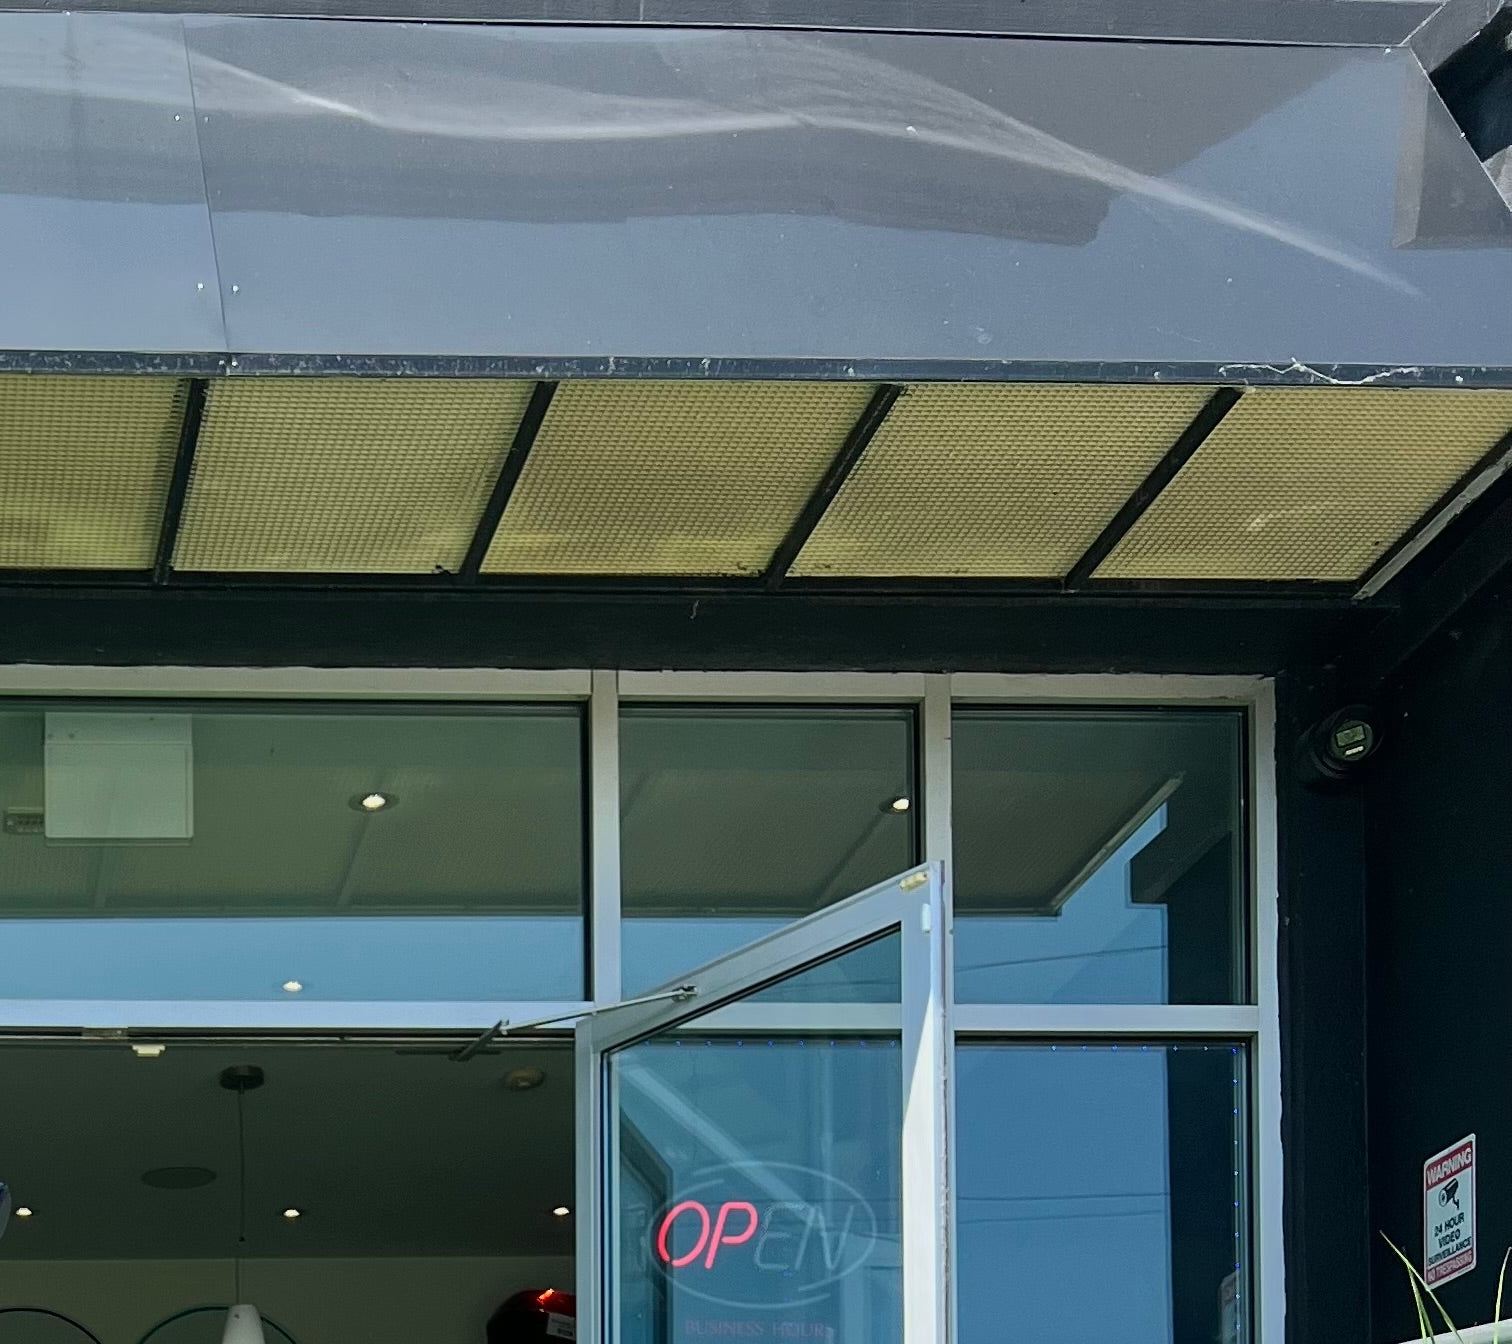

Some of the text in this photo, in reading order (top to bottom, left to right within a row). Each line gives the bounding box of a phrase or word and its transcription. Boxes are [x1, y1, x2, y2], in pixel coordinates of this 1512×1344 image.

[1427, 1148, 1472, 1186] WARNING
[1444, 1212, 1465, 1233] HOUR
[657, 1200, 856, 1271] OPEN
[1438, 1228, 1461, 1249] VIDEO
[685, 1320, 764, 1336] BUSINESS
